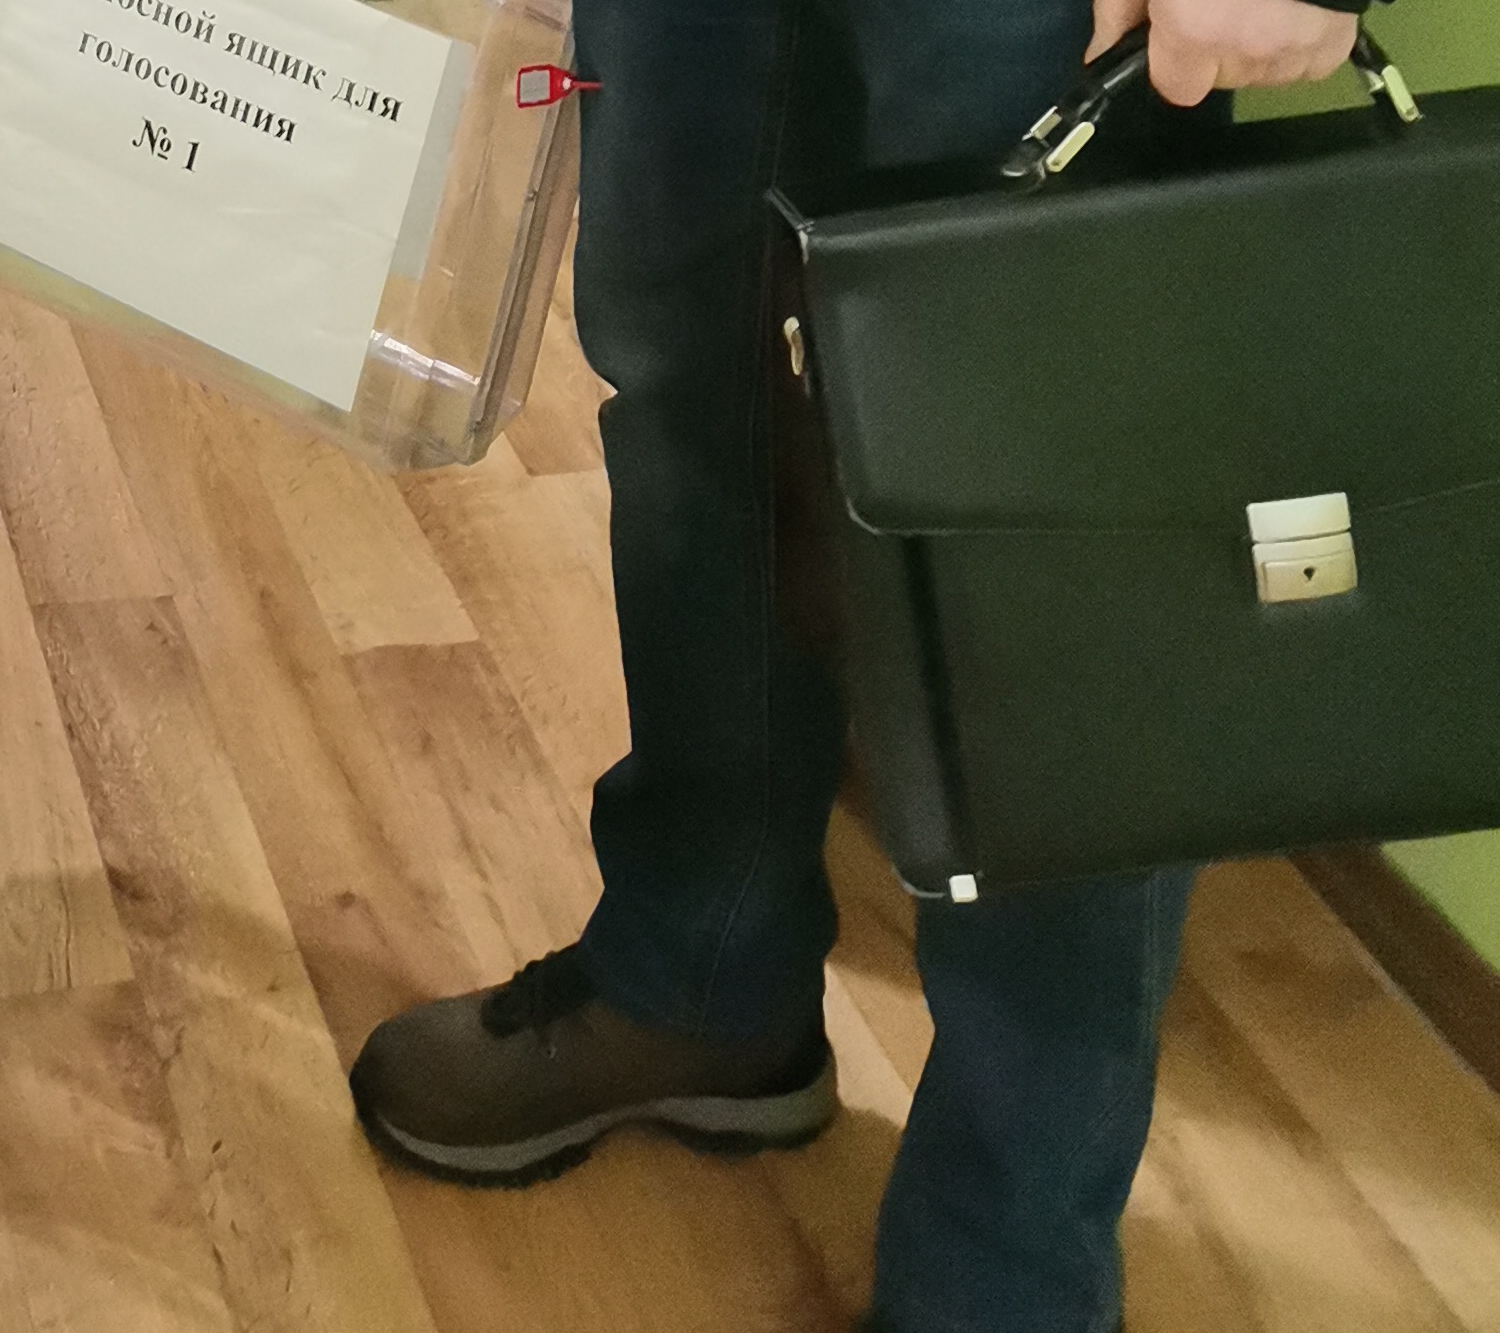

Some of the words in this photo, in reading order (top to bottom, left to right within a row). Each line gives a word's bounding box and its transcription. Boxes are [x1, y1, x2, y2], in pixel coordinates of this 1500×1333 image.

[78, 31, 298, 145] голосования
[224, 32, 328, 92] ящик
[331, 76, 405, 123] для
[131, 116, 173, 161] №
[181, 140, 201, 174] 1
